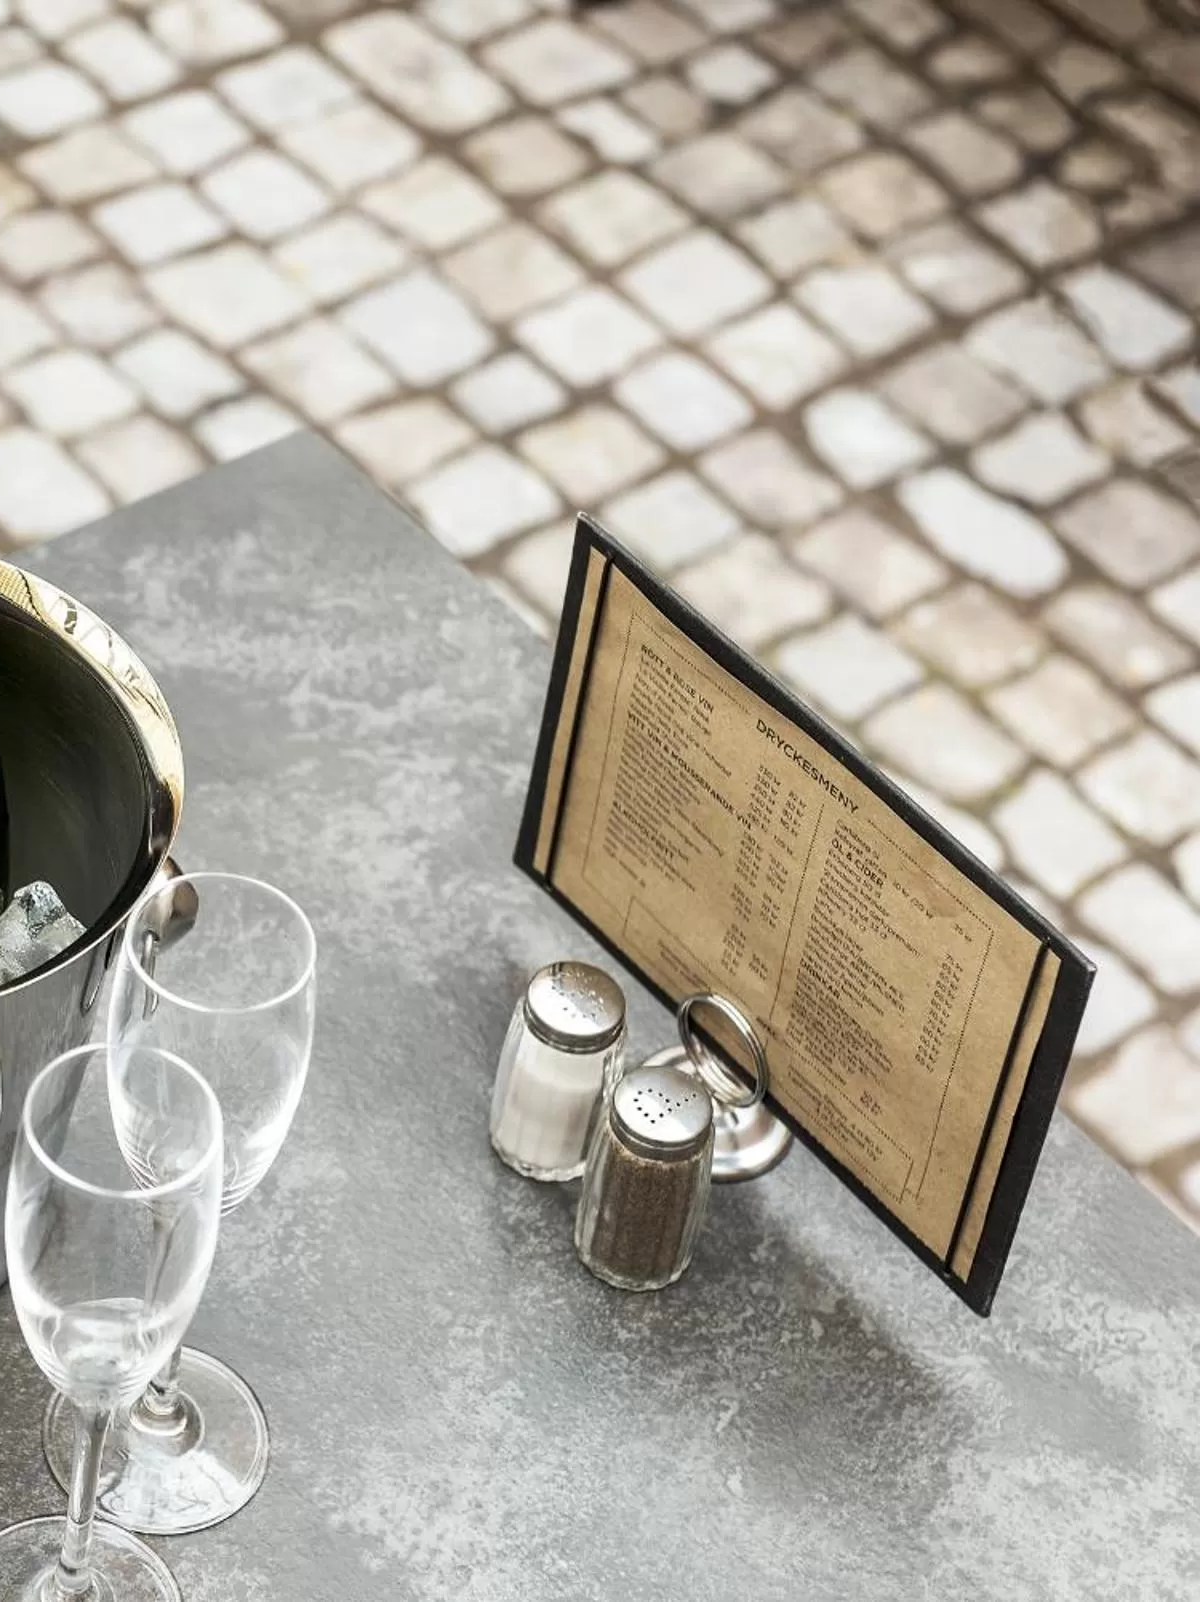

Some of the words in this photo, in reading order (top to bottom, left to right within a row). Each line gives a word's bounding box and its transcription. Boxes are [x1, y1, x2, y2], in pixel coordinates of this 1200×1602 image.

[698, 694, 712, 713] VIN
[755, 717, 858, 817] DRYCKESMENY
[831, 836, 844, 855] ÖL
[846, 849, 852, 861] &
[855, 857, 883, 889] CIDER
